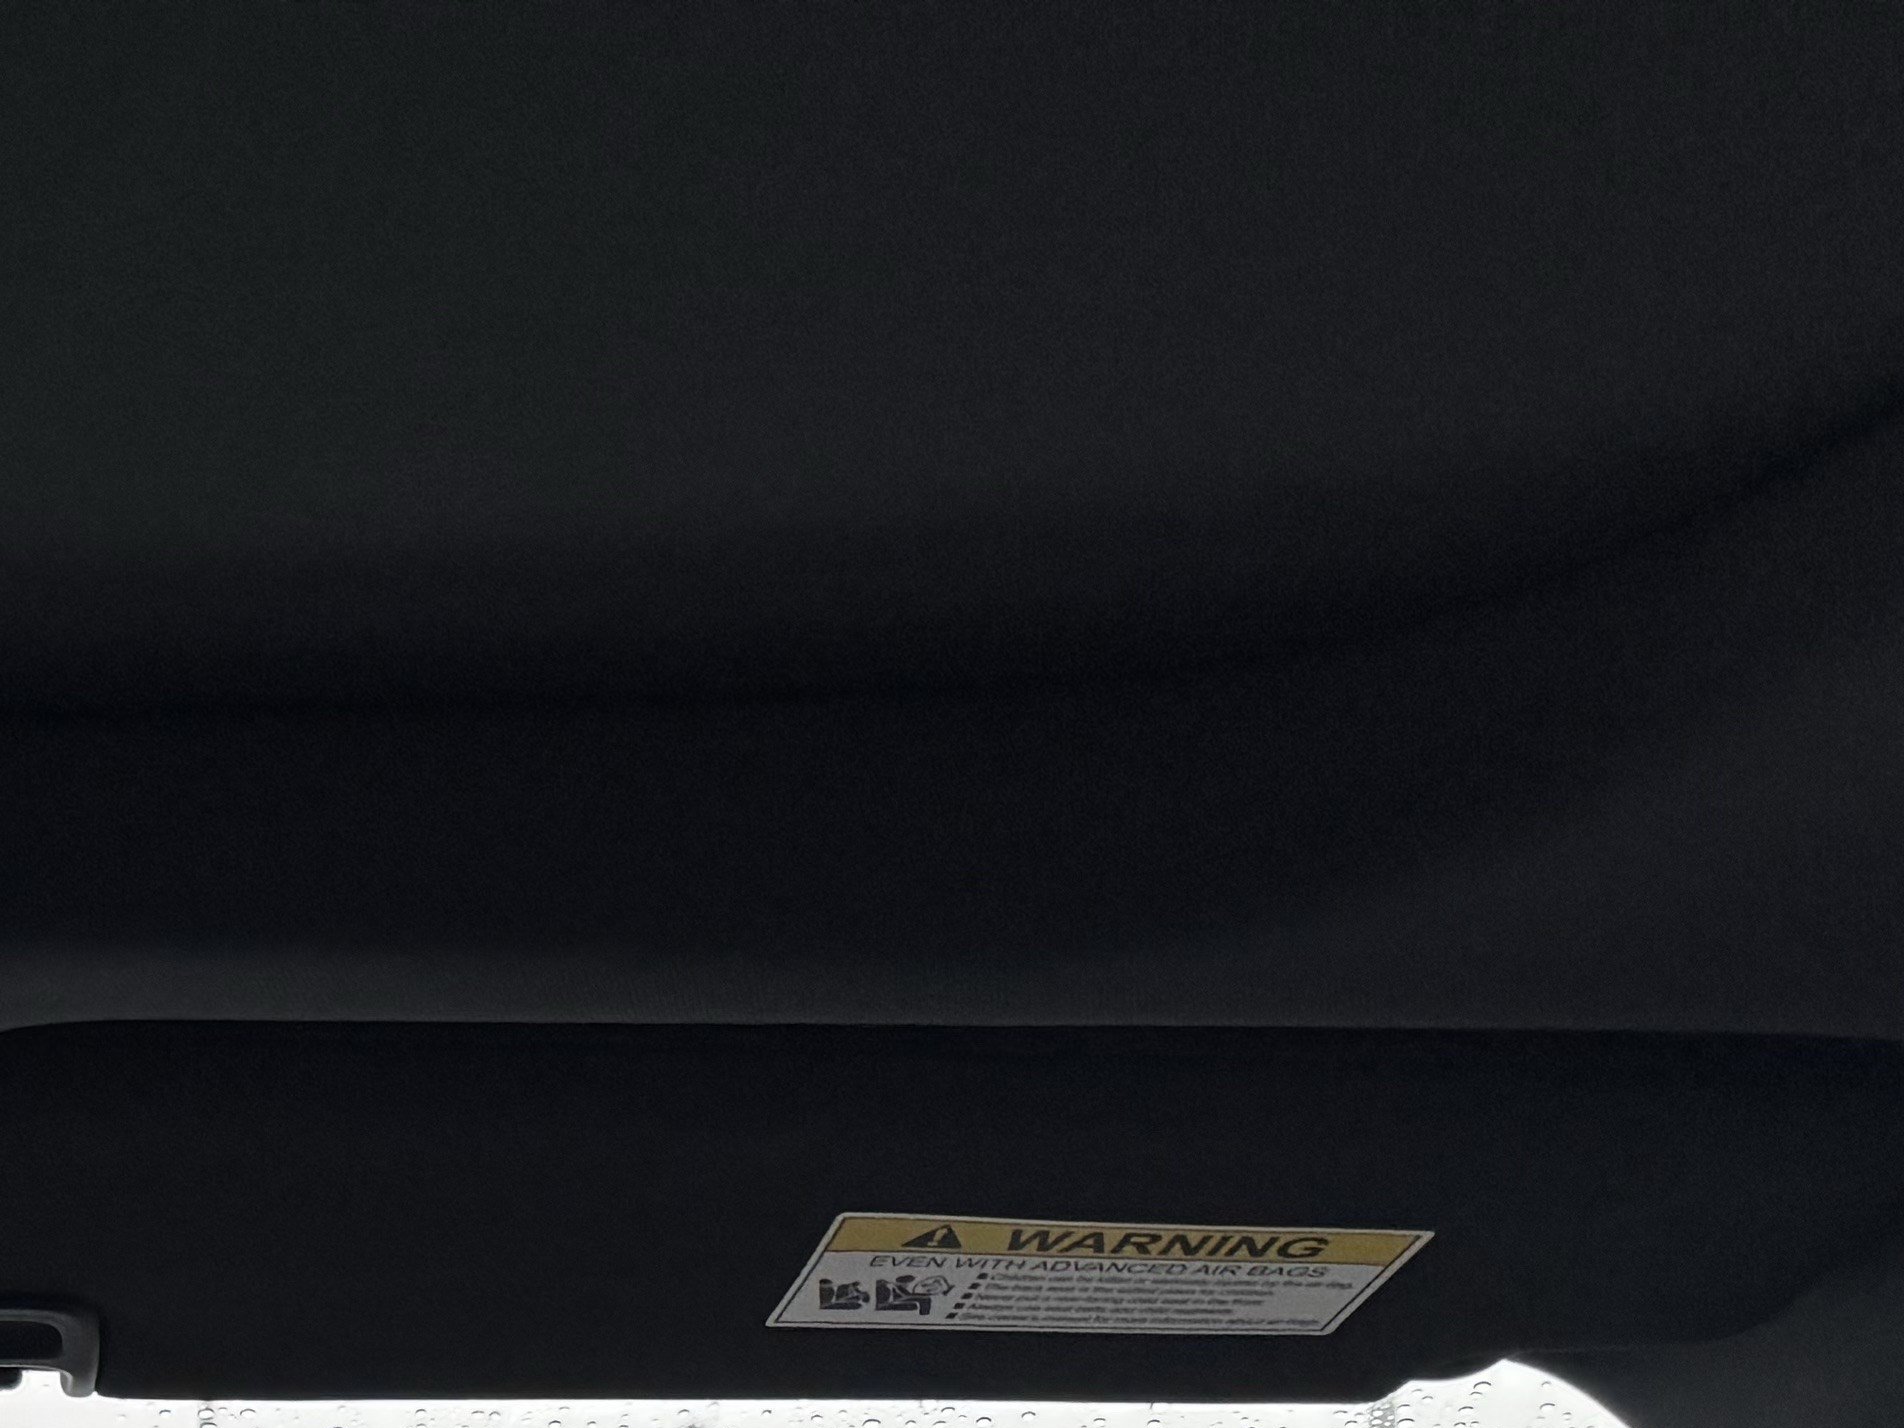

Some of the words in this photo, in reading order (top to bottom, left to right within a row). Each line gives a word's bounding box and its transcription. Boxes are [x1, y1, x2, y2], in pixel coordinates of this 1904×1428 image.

[1005, 1227, 1329, 1259] WARNING
[869, 1254, 947, 1270] EVEN
[954, 1256, 1027, 1273] WITH
[1031, 1259, 1187, 1277] ADVANCED
[1190, 1263, 1240, 1278] AIR
[1246, 1265, 1328, 1279] BAGS
